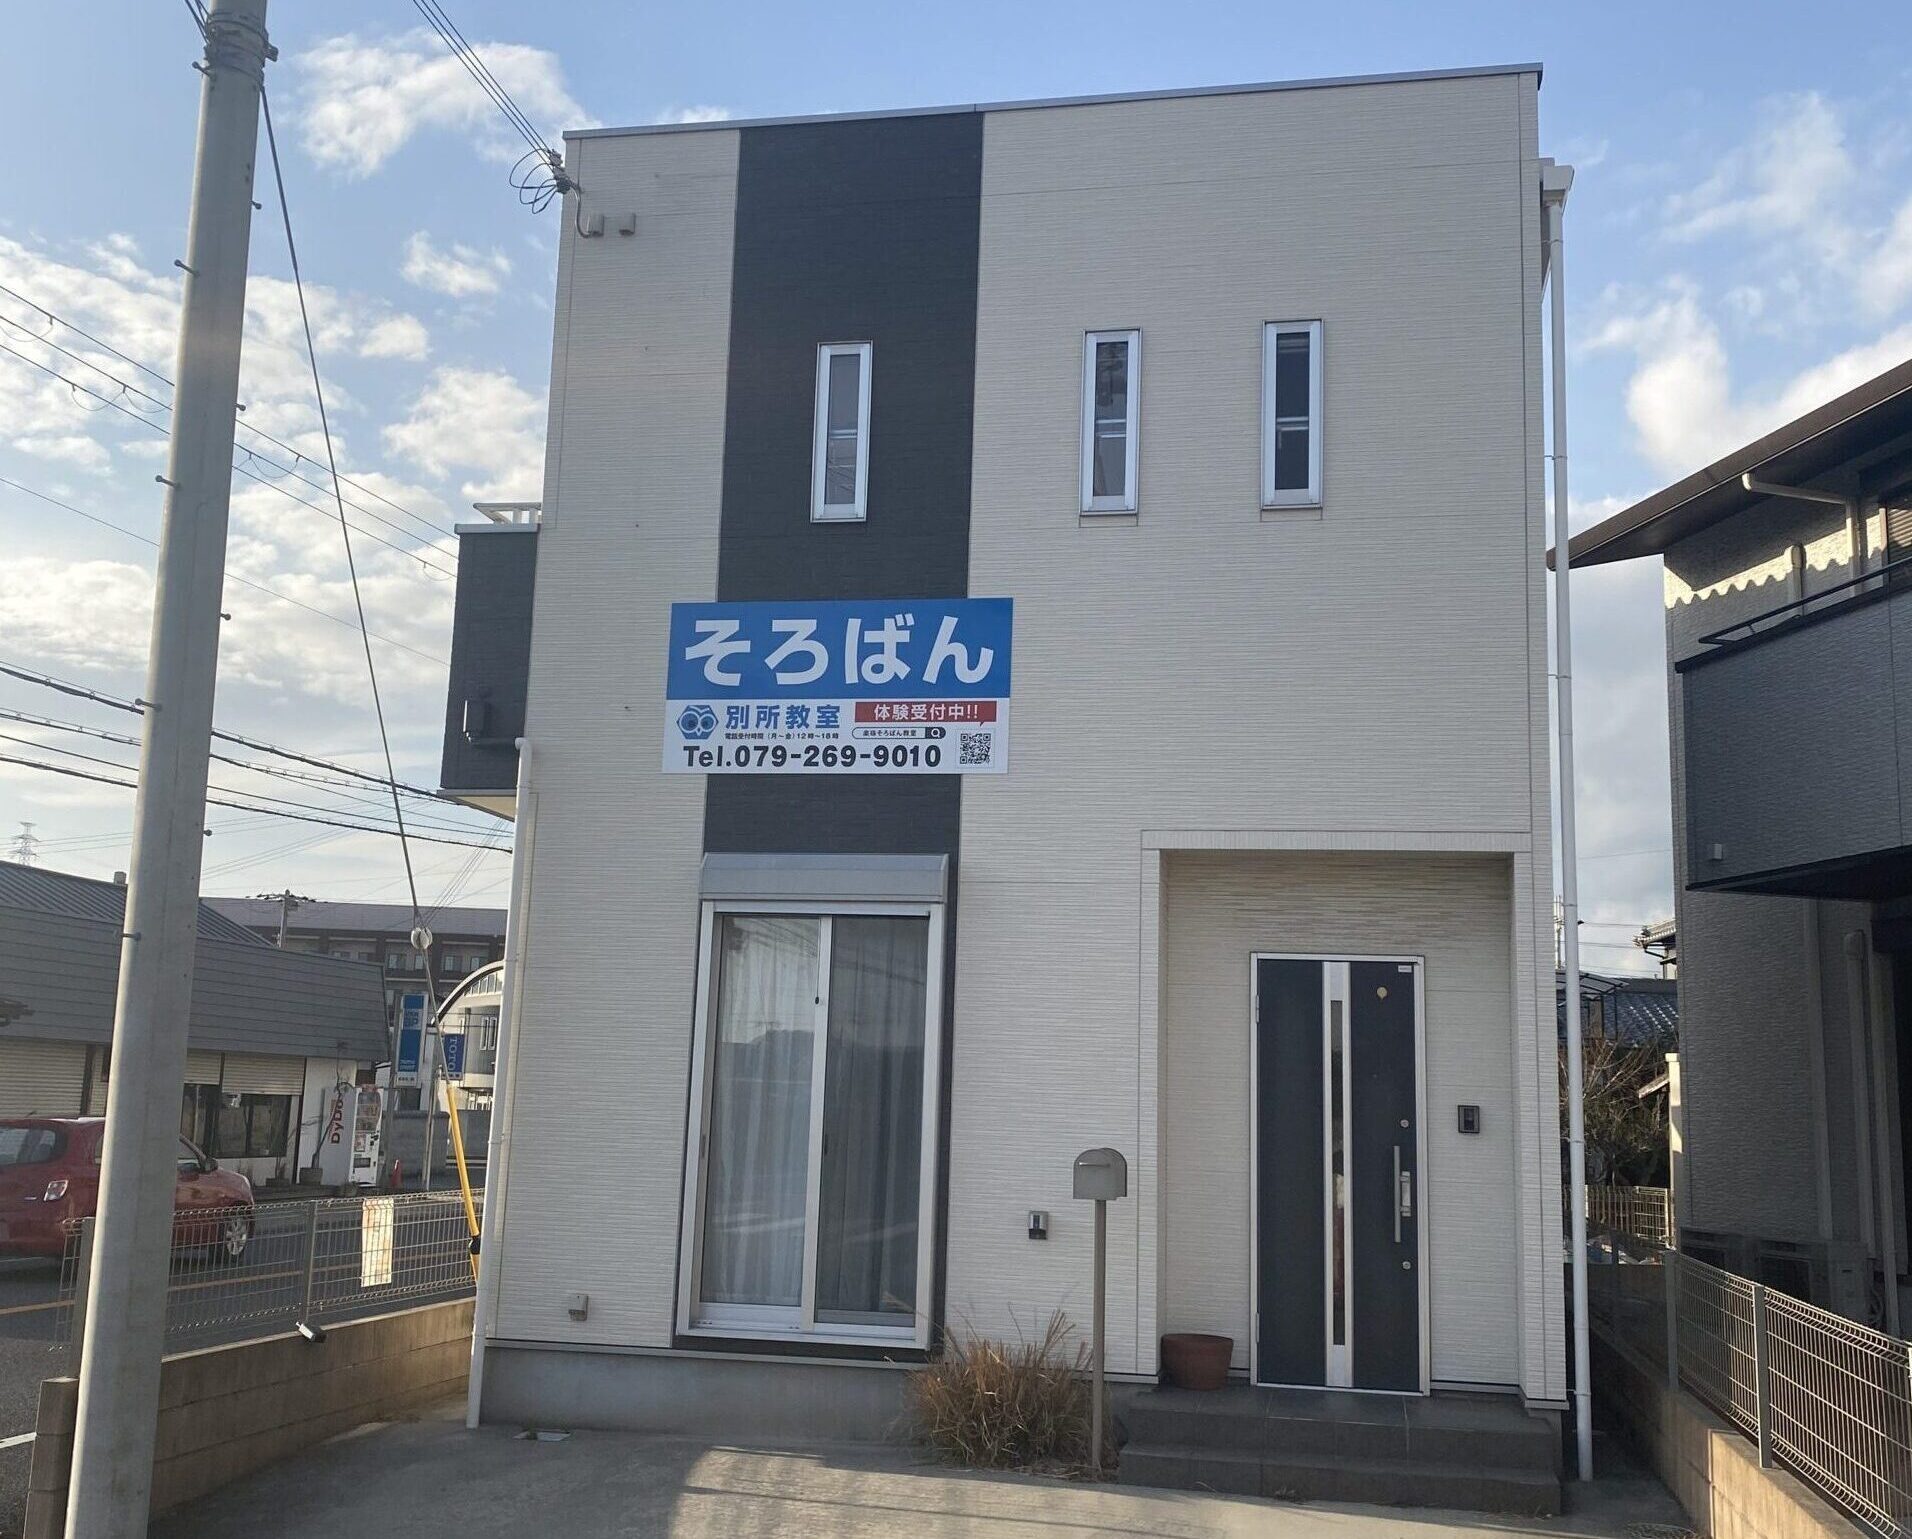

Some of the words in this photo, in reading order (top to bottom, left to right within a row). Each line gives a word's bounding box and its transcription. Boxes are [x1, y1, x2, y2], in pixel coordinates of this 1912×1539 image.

[684, 612, 995, 687] そろばん
[725, 704, 841, 730] 別所教室
[873, 703, 979, 721] 体験受付中!!
[683, 744, 942, 768] Tel.079-269-9010
[447, 1036, 458, 1071] TOTO
